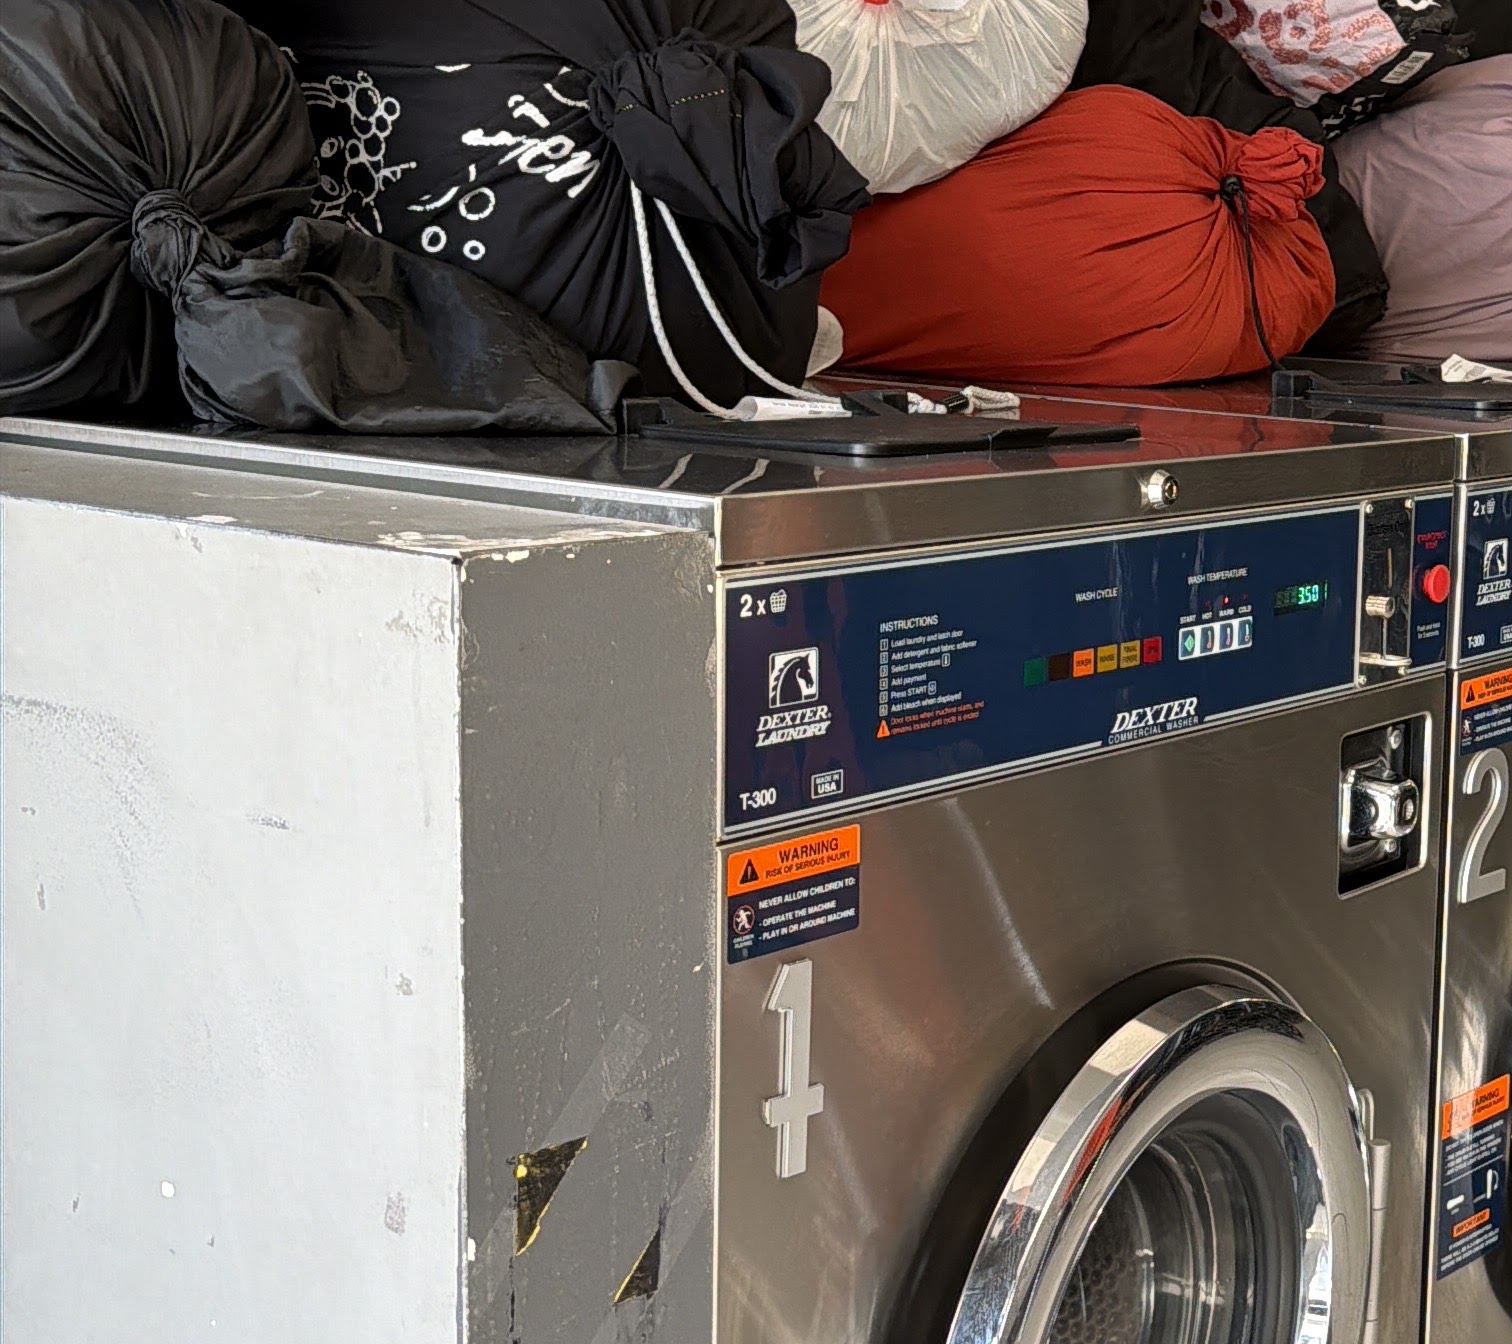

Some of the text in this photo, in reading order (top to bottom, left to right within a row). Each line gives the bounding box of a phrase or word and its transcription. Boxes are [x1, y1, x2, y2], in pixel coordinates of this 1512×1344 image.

[1473, 500, 1480, 516] 2
[1206, 567, 1249, 583] TEMPERATURE
[1477, 578, 1512, 595] DEXTER
[740, 594, 752, 618] 2
[1075, 587, 1118, 603] WASH CYCLE
[880, 615, 938, 633] INSTRUCTIONS
[1467, 634, 1485, 649] T-300
[908, 686, 927, 696] START
[756, 705, 831, 732] DEXTER
[1110, 697, 1198, 734] DEXTER
[755, 720, 831, 748] LAUNDRY
[1108, 716, 1199, 745] COMMERCIAL WASHER
[740, 788, 777, 810] T-300
[817, 782, 837, 794] USA
[1457, 747, 1509, 903] 2
[779, 838, 838, 864] WARNING
[765, 851, 850, 879] RISK OF SERIOUS INJURY
[759, 896, 783, 909] NEVER
[784, 888, 809, 903] ALLOW
[809, 880, 843, 896] CHILDREN
[762, 900, 837, 927] OPERATE THE MACHINE
[762, 908, 855, 940] PLAY IN OR AROUND MACHINE
[762, 958, 824, 1179] 1
